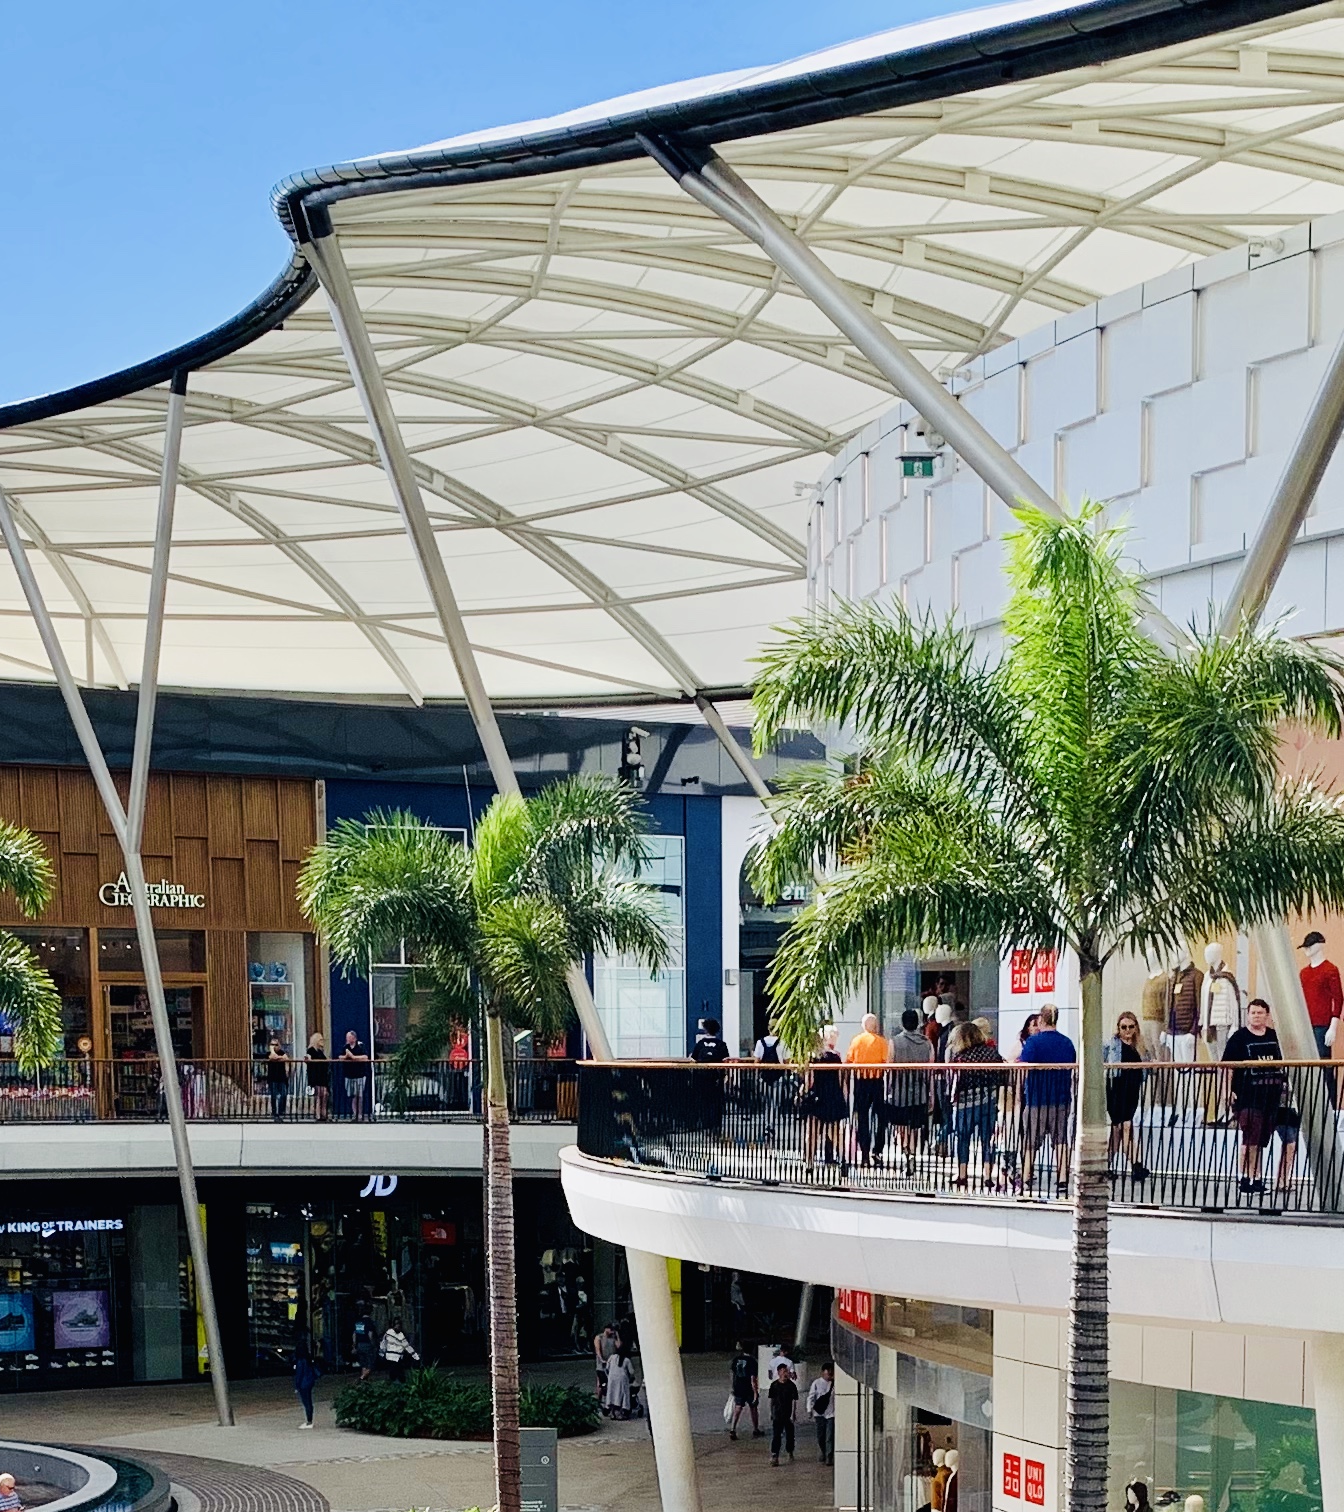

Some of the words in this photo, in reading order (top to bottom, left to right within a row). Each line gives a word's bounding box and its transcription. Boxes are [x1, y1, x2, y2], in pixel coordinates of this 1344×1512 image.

[115, 871, 185, 894] Atralian
[1037, 971, 1054, 989] QLO
[360, 1175, 397, 1197] JD
[8, 1222, 40, 1233] KING
[42, 1222, 55, 1230] OF
[56, 1219, 123, 1231] TRAINERS
[1027, 1465, 1042, 1482] UNI
[1027, 1482, 1043, 1499] QLO
